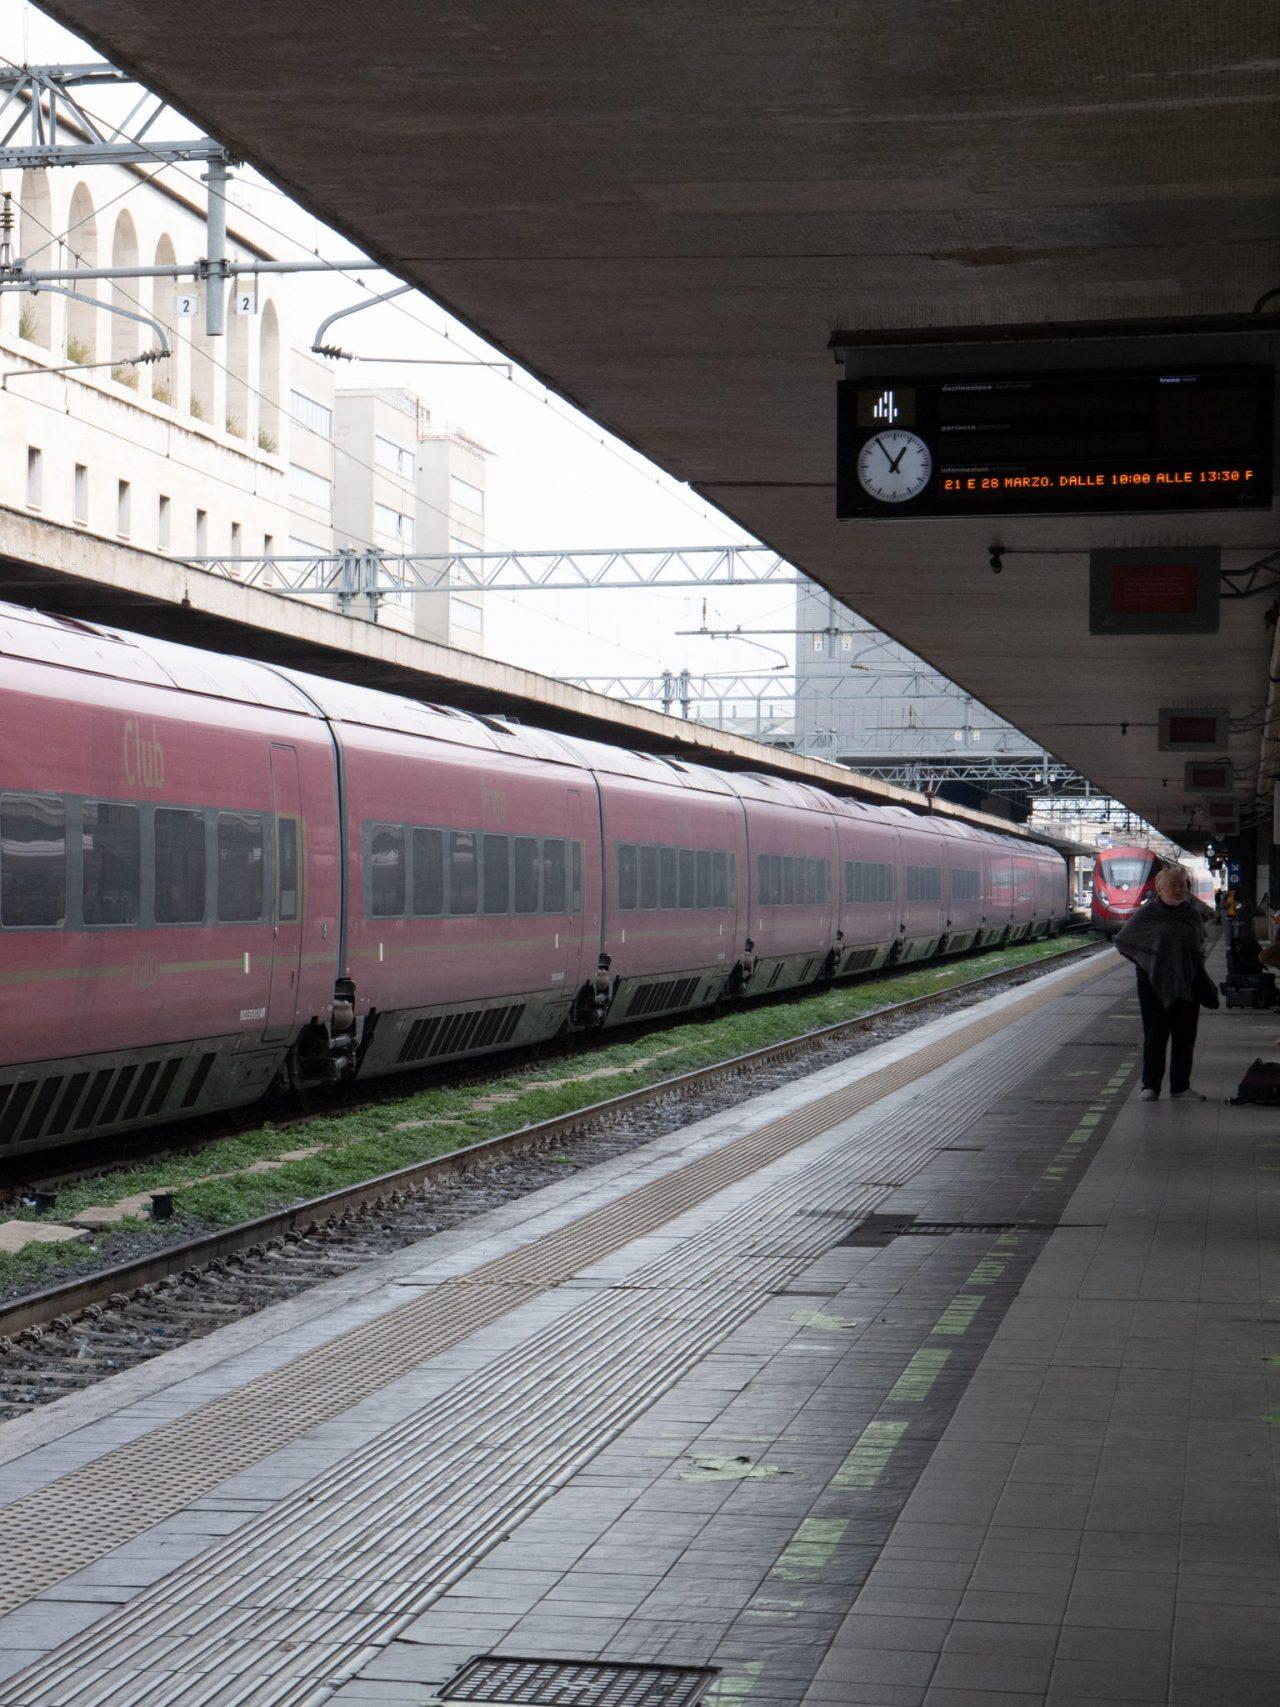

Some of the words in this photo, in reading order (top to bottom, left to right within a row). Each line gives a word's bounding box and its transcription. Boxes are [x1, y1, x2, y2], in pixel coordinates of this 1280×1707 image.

[183, 299, 190, 312] 2
[242, 297, 249, 310] 2
[942, 384, 992, 392] destinazione
[941, 424, 976, 432] partenza
[941, 466, 989, 474] informazioni
[944, 480, 961, 490] 21
[967, 479, 977, 489] E
[981, 478, 999, 489] 28
[1059, 475, 1105, 487] DALLE
[1111, 474, 1151, 486] 10:00
[1156, 472, 1193, 484] ALLE
[1199, 470, 1240, 483] 13:30
[123, 719, 165, 789] Club
